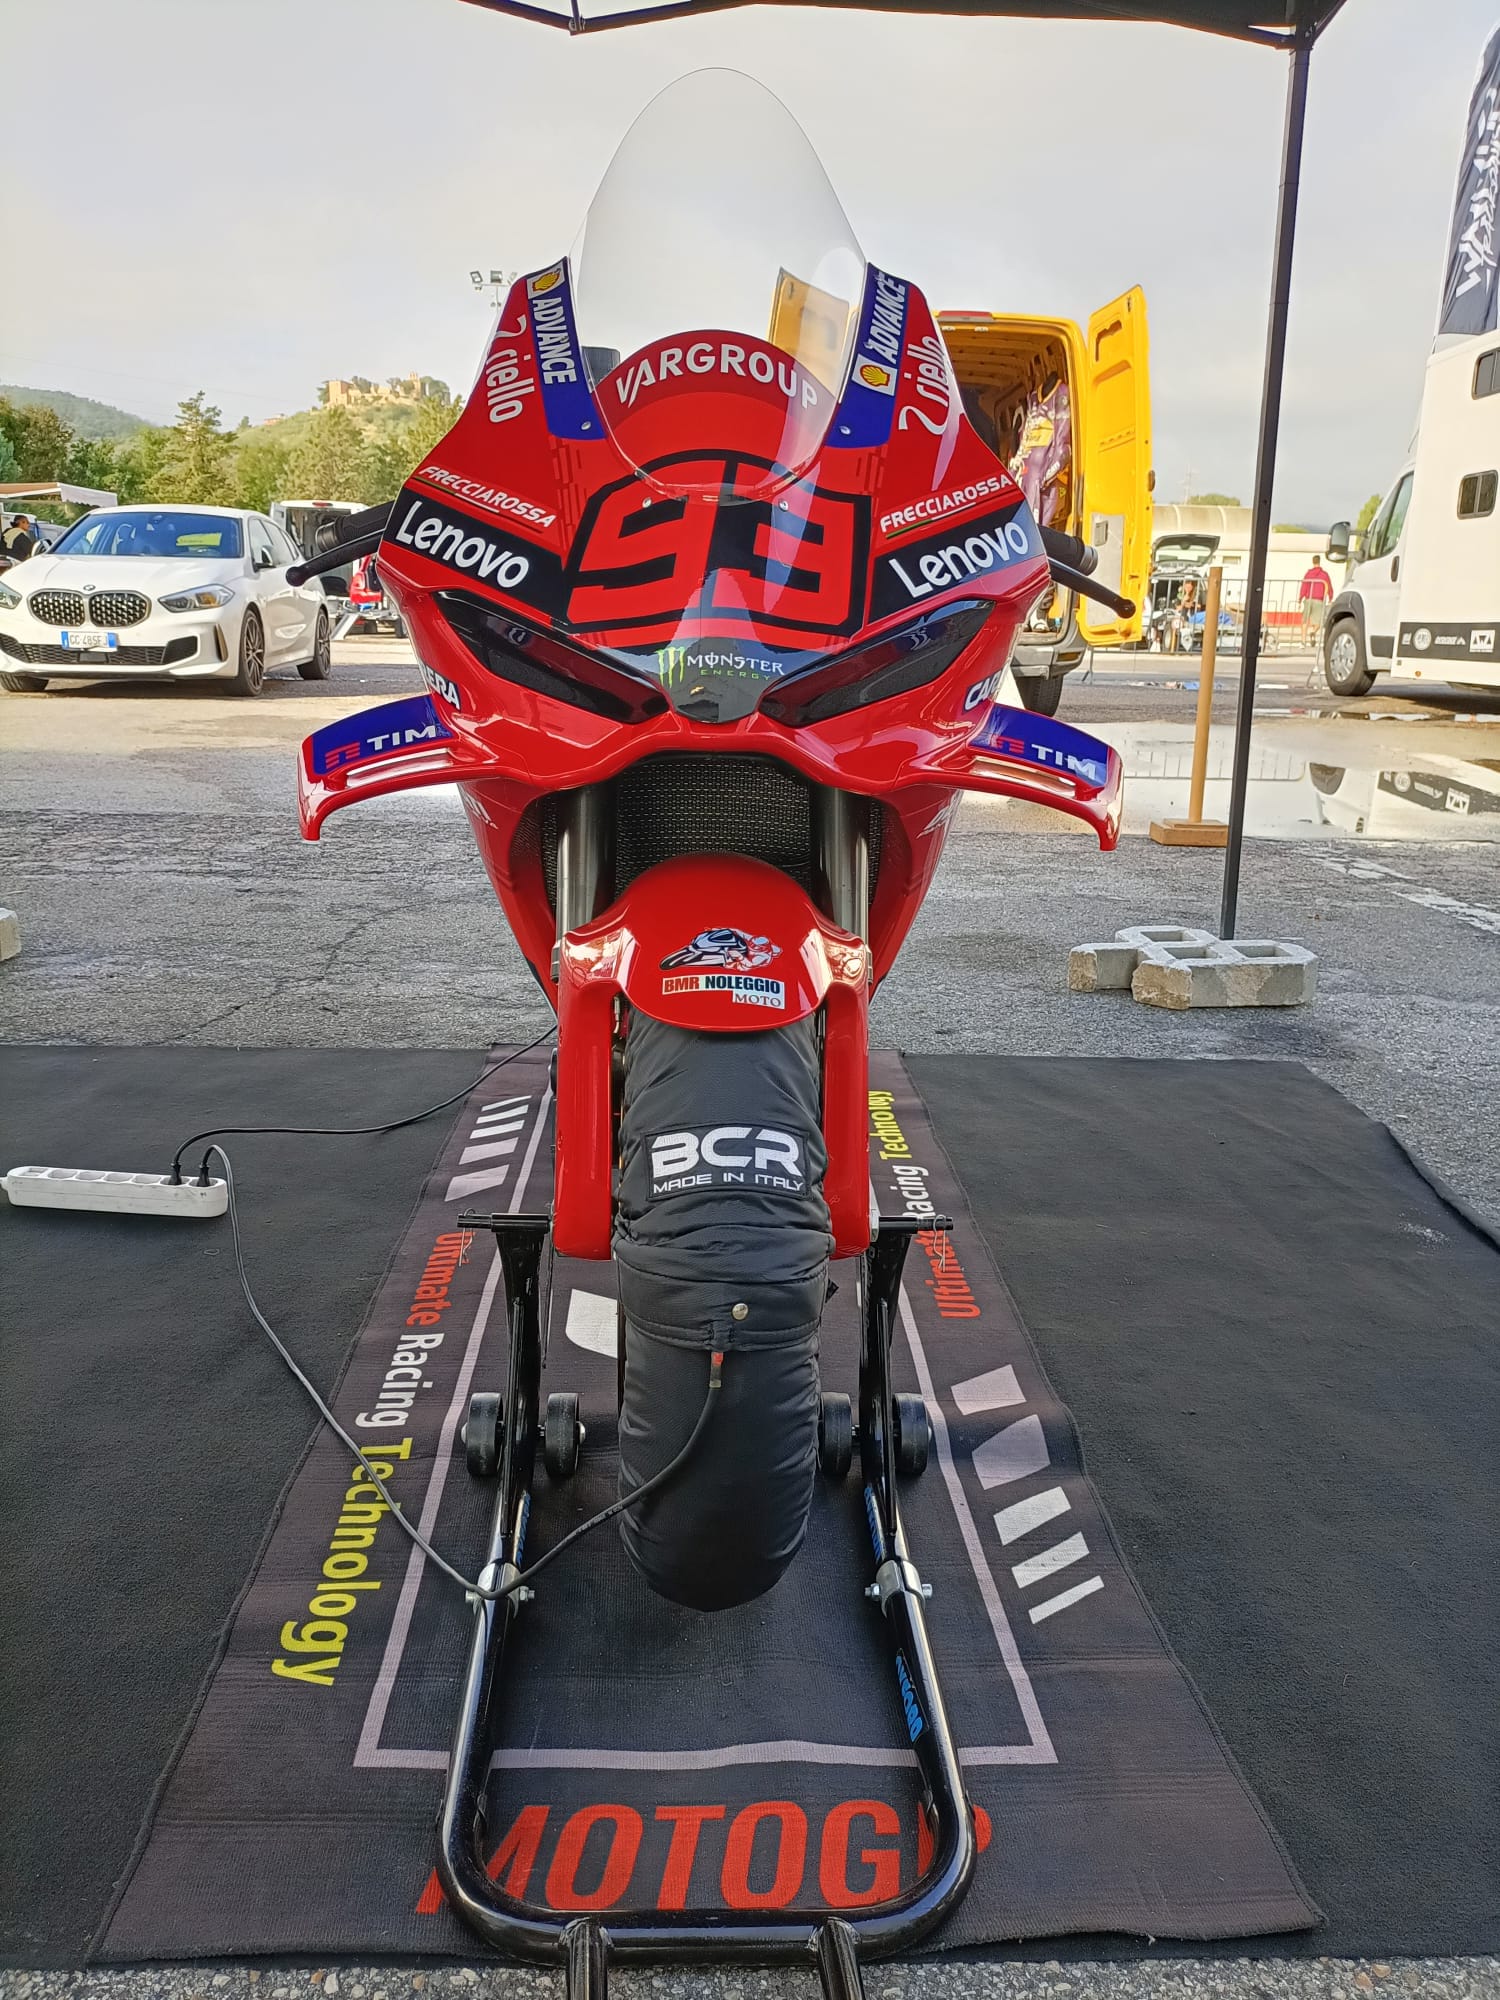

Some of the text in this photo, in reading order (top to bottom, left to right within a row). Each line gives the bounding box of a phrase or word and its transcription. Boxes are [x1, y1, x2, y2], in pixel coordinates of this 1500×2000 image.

[532, 297, 577, 385] ADVANCE
[866, 269, 906, 364] ADVANCE
[418, 465, 558, 528] FRECCIAROSSA
[880, 474, 1013, 533] FRECCIAROSSA
[395, 500, 530, 589] Lenovo
[564, 455, 859, 629] 93
[889, 520, 1030, 599] Lenovo
[687, 651, 785, 676] MONSTER
[700, 669, 770, 681] ENERGY
[366, 724, 437, 752] TIM
[1031, 743, 1096, 780] TIM
[663, 975, 781, 995] BMR NOLEGGIO
[734, 993, 782, 1008] MOTO
[651, 1126, 803, 1178] BCR
[653, 1172, 804, 1194] MADE IN ITALY
[270, 1231, 476, 1688] Ultimate Racing Technology
